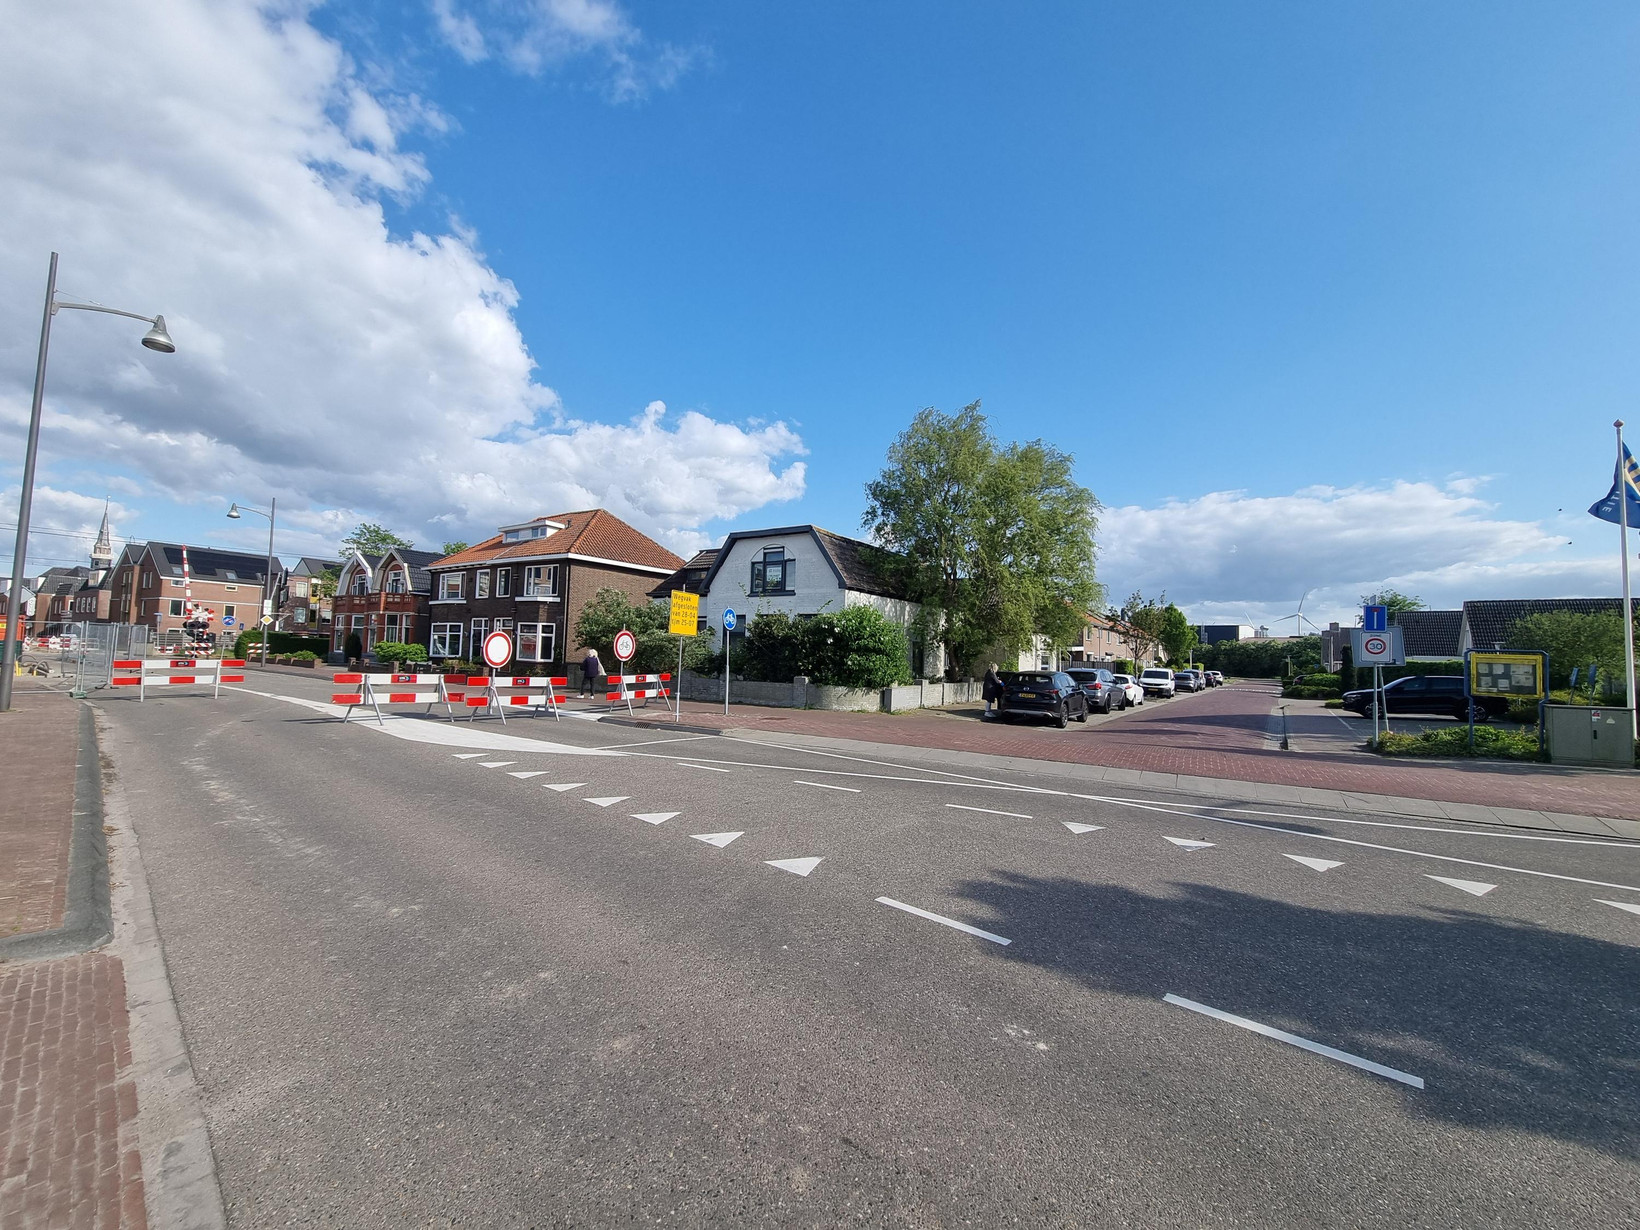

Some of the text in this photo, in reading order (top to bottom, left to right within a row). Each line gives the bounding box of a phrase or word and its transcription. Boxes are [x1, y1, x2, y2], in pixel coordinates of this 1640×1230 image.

[673, 593, 692, 602] Wegvak
[673, 602, 698, 611] afgesloten
[681, 611, 696, 619] 28-04
[1370, 642, 1382, 650] 30
